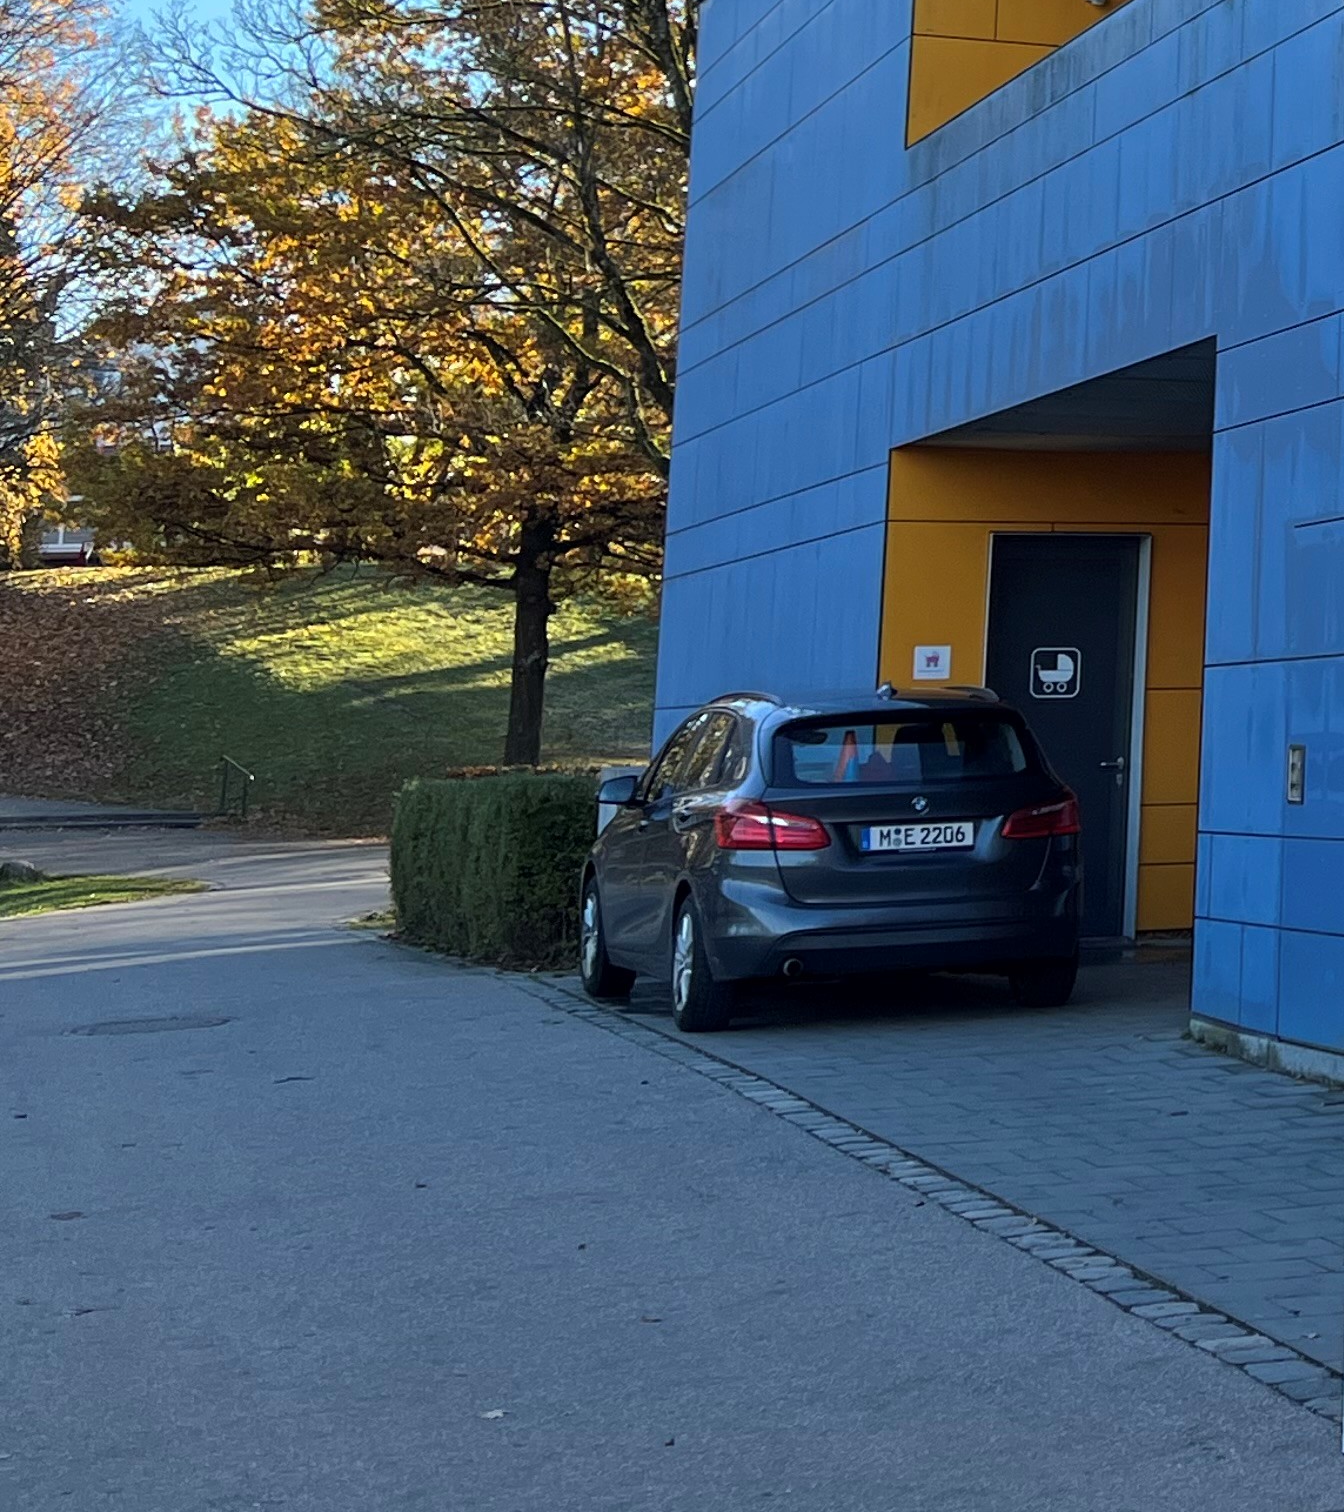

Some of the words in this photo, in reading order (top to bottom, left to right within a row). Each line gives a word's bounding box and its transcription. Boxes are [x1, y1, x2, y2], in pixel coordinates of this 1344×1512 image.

[879, 829, 891, 847] M
[904, 828, 916, 846] E
[920, 826, 966, 845] 2206
